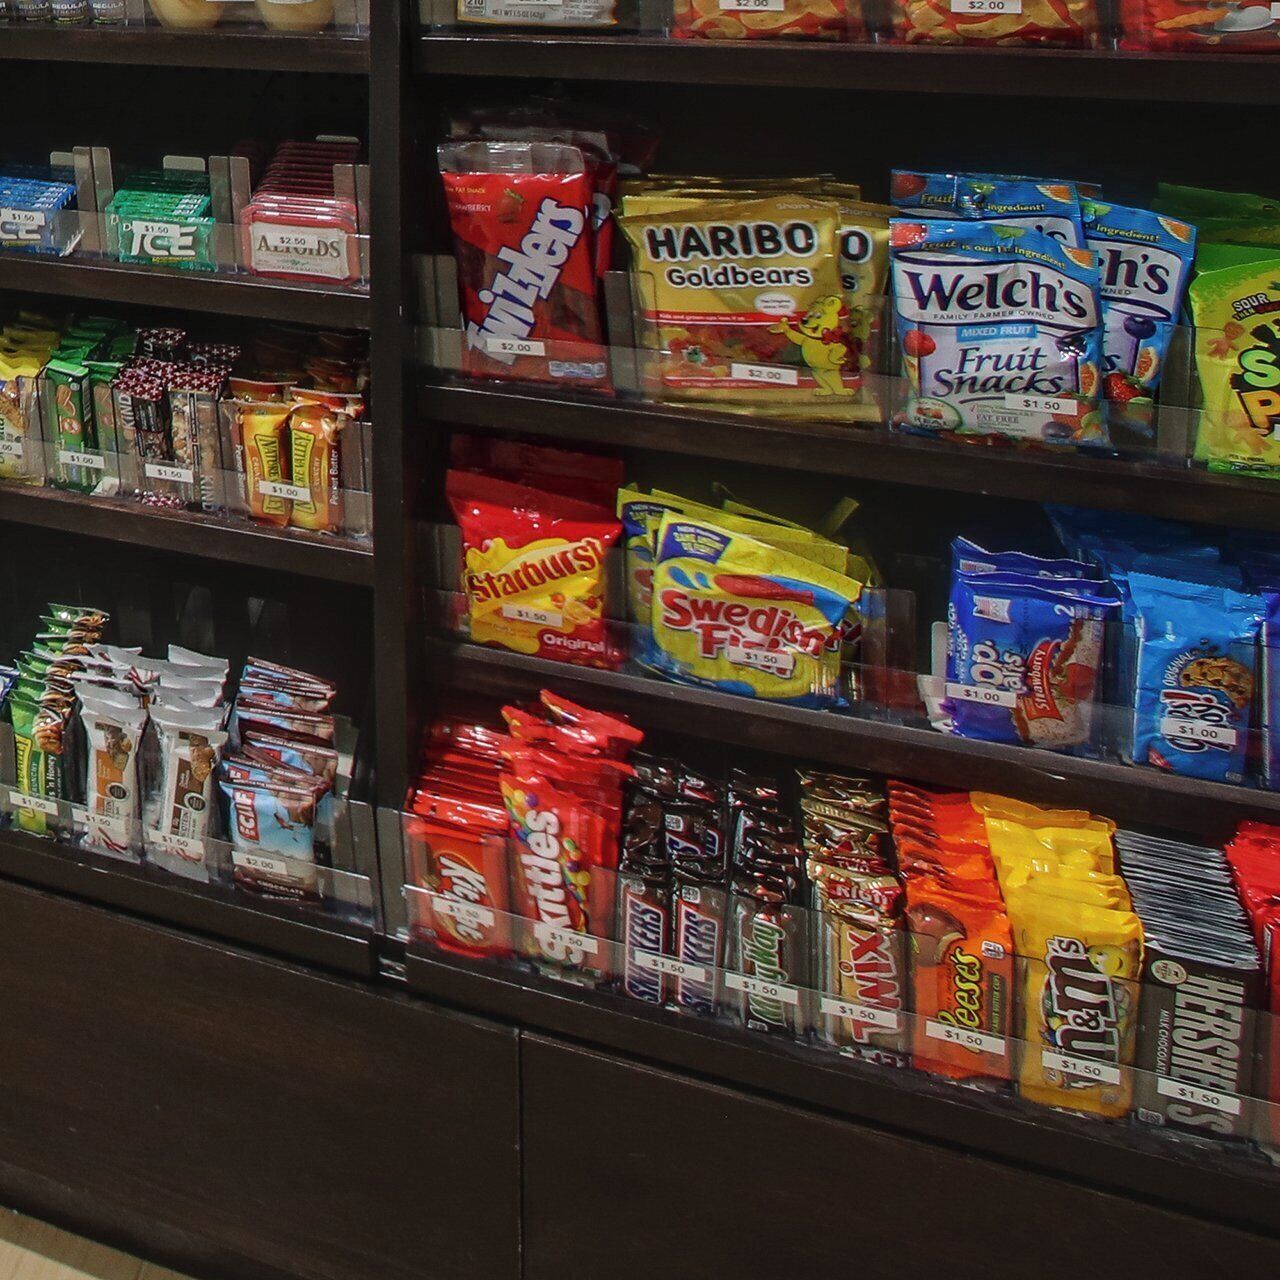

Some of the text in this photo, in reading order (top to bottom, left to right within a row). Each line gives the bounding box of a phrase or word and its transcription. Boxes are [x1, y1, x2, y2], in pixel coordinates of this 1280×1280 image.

[967, 0, 1006, 12] $2.00
[12, 213, 35, 222] $1.50
[144, 226, 168, 234] $1.50
[279, 237, 306, 246] $2.50
[644, 221, 818, 261] HARIBO
[664, 264, 812, 290] Goldbears
[903, 270, 1088, 319] Welch's
[1233, 293, 1269, 312] SOUR
[973, 309, 1014, 319] FARMER
[1019, 310, 1055, 320] OWNED
[961, 325, 1033, 337] MIXED FRUIT
[500, 342, 532, 352] $2.00
[954, 346, 1048, 375] Fruit
[748, 369, 782, 380] $2.00
[932, 368, 1064, 398] Snacks
[118, 394, 136, 429] KIND
[1023, 400, 1060, 410] $1.50
[71, 456, 94, 464] $1.00
[157, 469, 182, 478] $1.50
[330, 450, 338, 505] Peanut Butter
[272, 486, 298, 496] $1.00
[467, 536, 603, 604] Starburst
[516, 611, 548, 623] $1.50
[1054, 604, 1076, 619] 2
[542, 631, 606, 653] Original
[743, 651, 779, 666] $1.50
[1162, 650, 1196, 687] ORIGINAL
[1034, 649, 1050, 710] Strawberry
[963, 688, 1000, 702] $1.00
[1179, 724, 1219, 740] $1.00
[21, 798, 46, 810] $1.00
[162, 835, 189, 848] $1.50
[246, 856, 274, 869] $2.00
[256, 880, 304, 897] CHOCOLATE
[549, 931, 584, 947] $1.50
[651, 958, 685, 974] $1.50
[742, 980, 778, 996] $1.50
[839, 1005, 876, 1020] $1.50
[1160, 1009, 1173, 1031] MILK
[944, 1028, 983, 1046] $1.50
[1061, 1058, 1102, 1077] $1.50
[1177, 1086, 1221, 1106] $1.50
